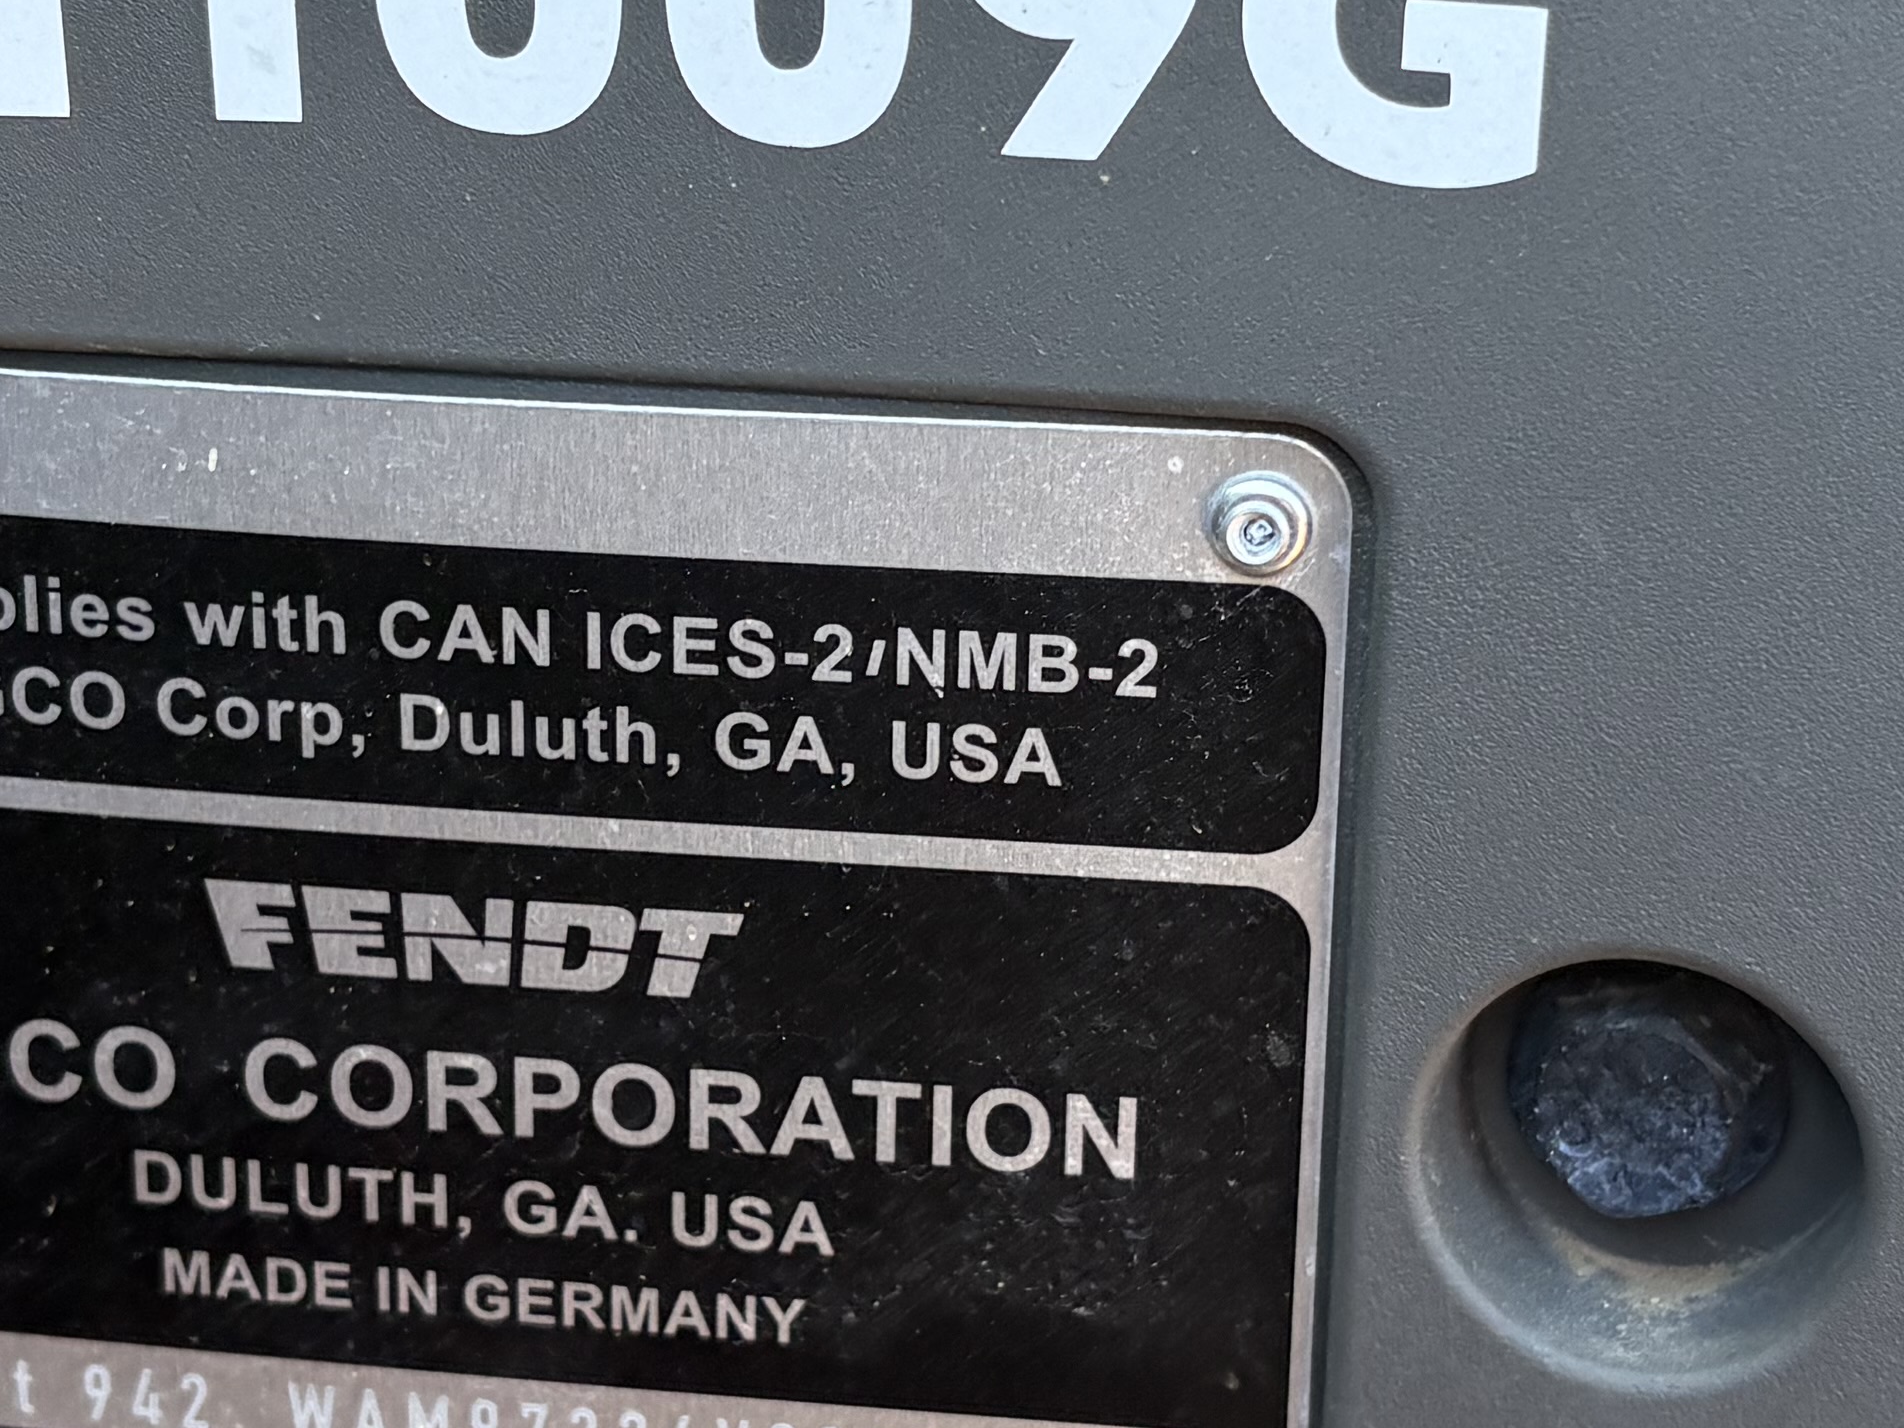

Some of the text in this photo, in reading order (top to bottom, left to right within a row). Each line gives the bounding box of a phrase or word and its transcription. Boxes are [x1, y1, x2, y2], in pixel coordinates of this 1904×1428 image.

[184, 596, 346, 653] with
[380, 600, 550, 667] CAN
[157, 677, 364, 758] Corp,
[400, 693, 680, 777] Duluth,
[715, 711, 855, 786] GA,
[892, 720, 1062, 787] USA
[204, 878, 744, 998] FENDT
[244, 1038, 1142, 1180] CORPORATION
[134, 1150, 834, 1256] DULUTH, GA. USA
[162, 1248, 807, 1344] MADE IN GERMANY
